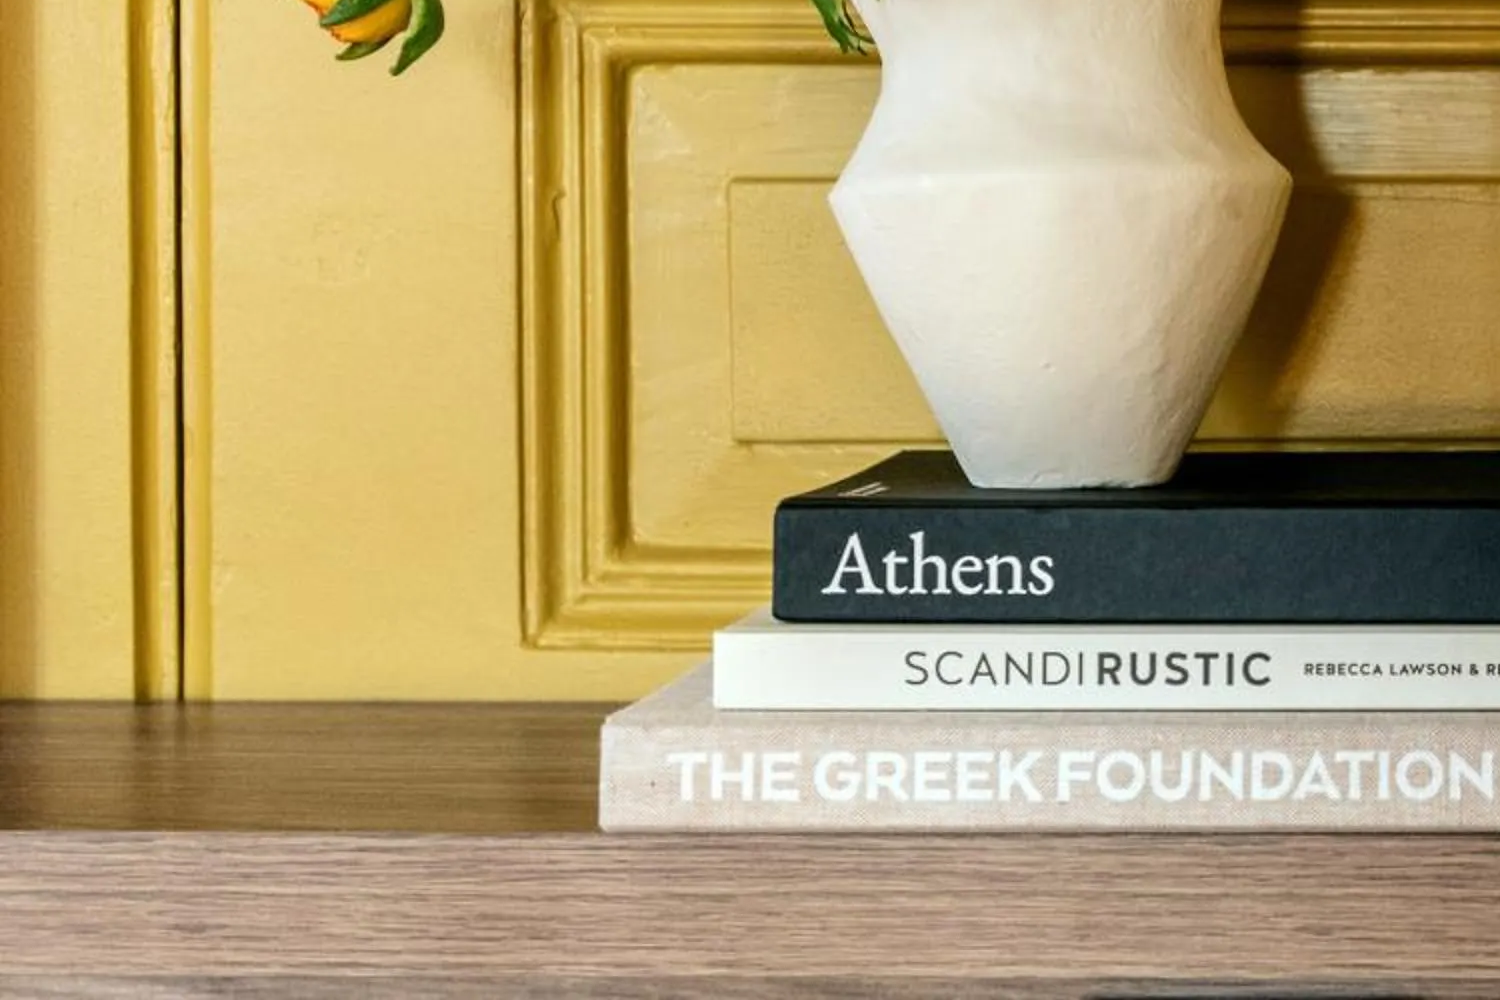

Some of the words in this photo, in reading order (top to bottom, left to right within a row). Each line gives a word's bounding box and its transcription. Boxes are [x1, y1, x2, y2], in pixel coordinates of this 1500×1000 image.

[822, 531, 1055, 596] Athens
[1303, 662, 1383, 677] REBECCA
[1389, 662, 1463, 677] LAWSON
[1469, 662, 1480, 677] &
[666, 750, 801, 802] THE
[813, 750, 1043, 802] GREEK
[1056, 750, 1494, 802] FOUNDATION
